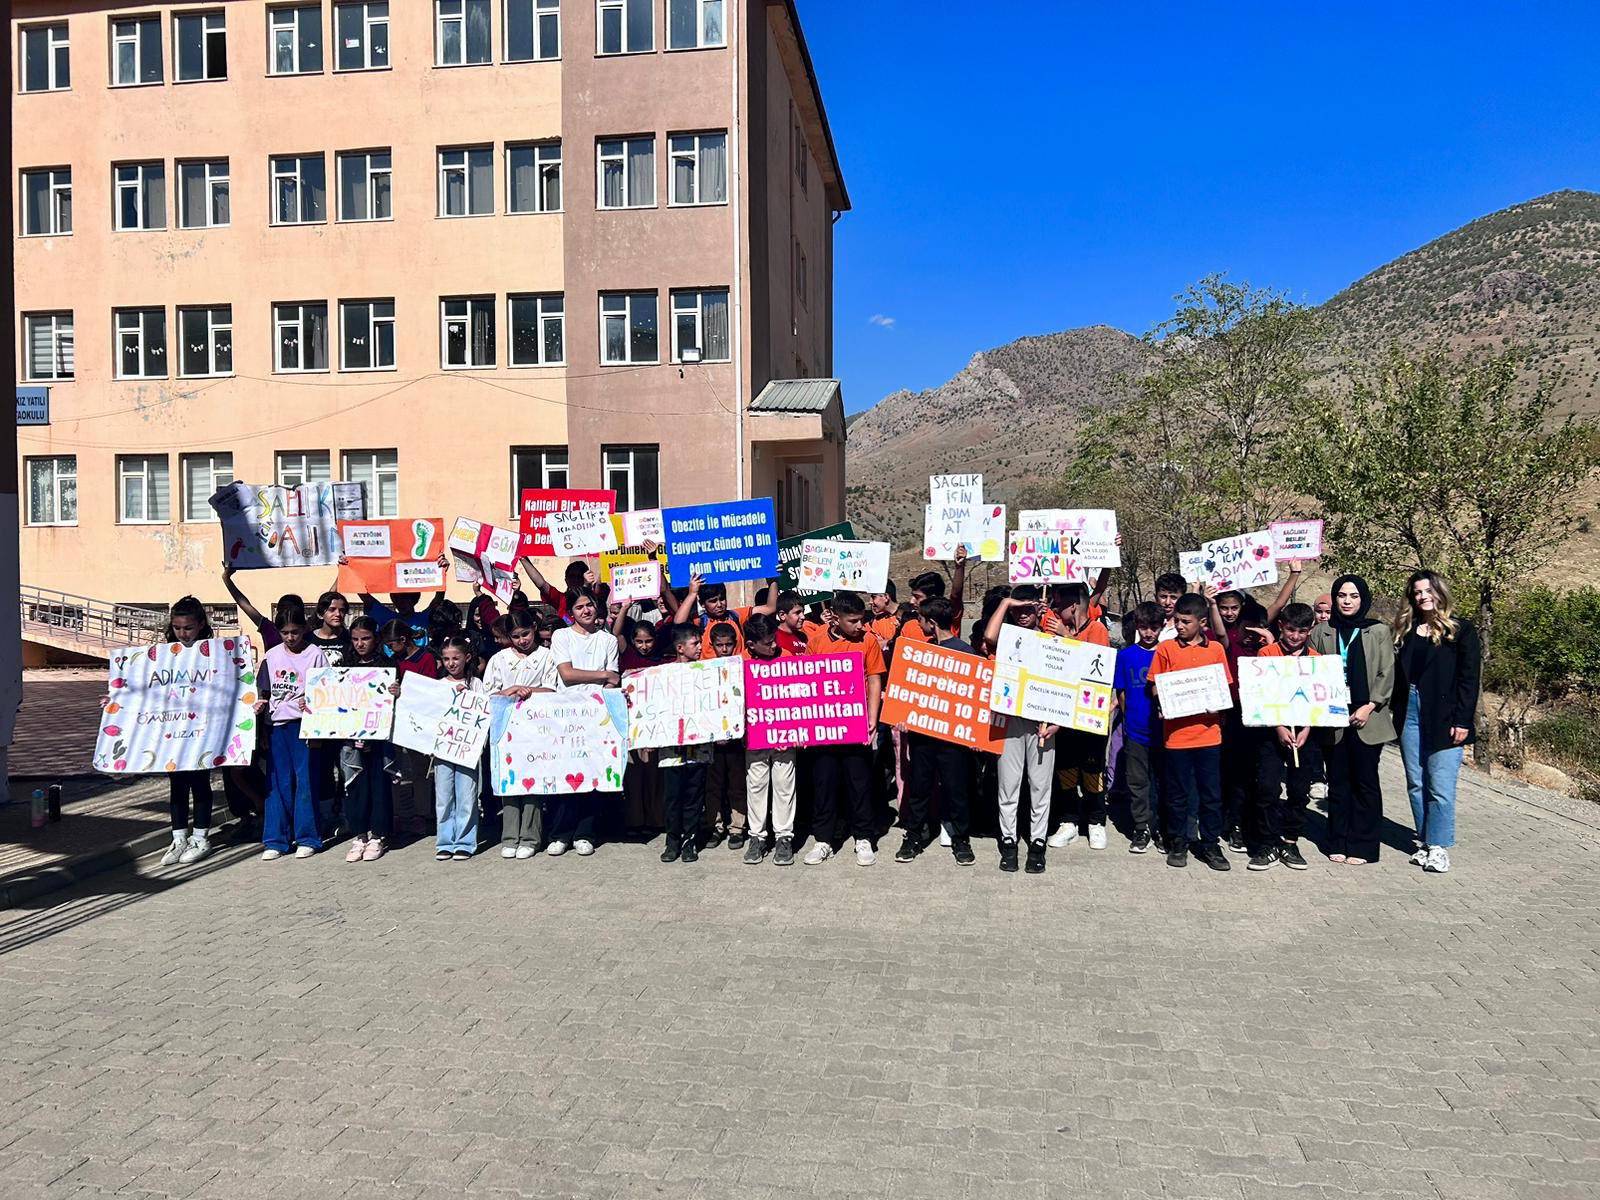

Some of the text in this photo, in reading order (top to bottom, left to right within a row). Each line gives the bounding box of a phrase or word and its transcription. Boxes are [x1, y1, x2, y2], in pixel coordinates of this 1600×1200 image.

[28, 397, 46, 406] YATILI
[16, 411, 45, 420] AOKULU
[525, 499, 559, 512] Kaliteli
[561, 500, 578, 512] Bir
[942, 507, 970, 521] ADIM
[671, 511, 767, 533] Obezite İle Mücadele
[944, 520, 963, 536] AT
[744, 535, 754, 548] 10
[756, 533, 772, 547] Bin
[713, 557, 762, 573] Yürüyoruz
[1211, 560, 1253, 581] ADIM
[1252, 570, 1270, 584] AT
[750, 658, 853, 679] Yediklerine
[902, 646, 971, 677] Sağlığın
[168, 685, 190, 700] AT
[824, 680, 846, 697] Et.
[905, 667, 976, 700] Hareket
[888, 684, 950, 714] Hergün
[954, 702, 973, 720] 10
[443, 707, 487, 729] MEK
[747, 702, 864, 727] Şişmanlıktan
[767, 725, 848, 744] Uzak Dur
[906, 711, 977, 743] Adım At.
